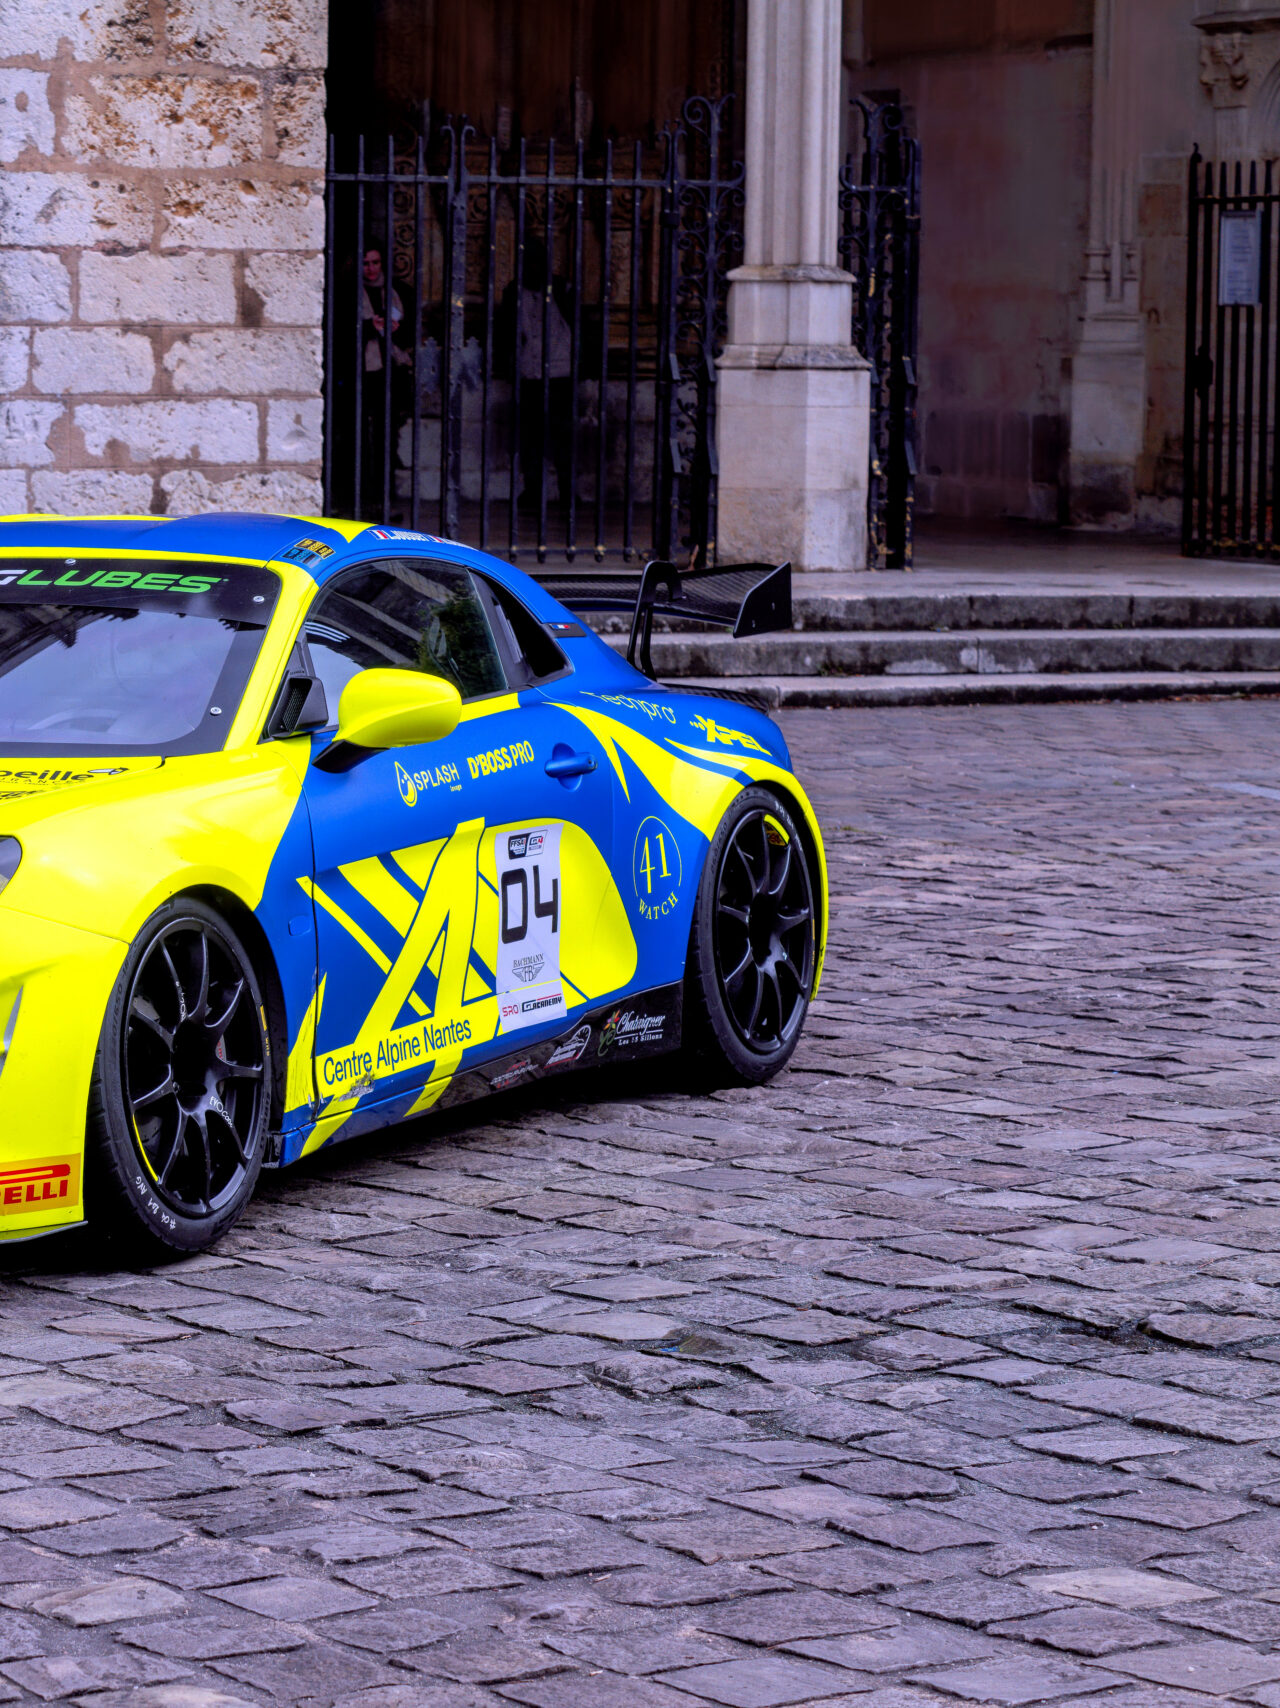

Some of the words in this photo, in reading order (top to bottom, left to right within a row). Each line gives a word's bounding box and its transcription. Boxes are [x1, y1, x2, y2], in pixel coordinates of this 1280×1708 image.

[693, 714, 773, 756] XPEL
[413, 762, 461, 791] SPLASH
[466, 746, 513, 779] D'BOSS
[509, 740, 535, 766] PRO
[639, 832, 672, 894] 41
[501, 864, 559, 945] 04
[638, 891, 679, 920] WATCH
[502, 1004, 519, 1017] SRO
[323, 1050, 373, 1086] Centre
[376, 1034, 421, 1071] Alpine
[423, 1019, 472, 1053] Nantes
